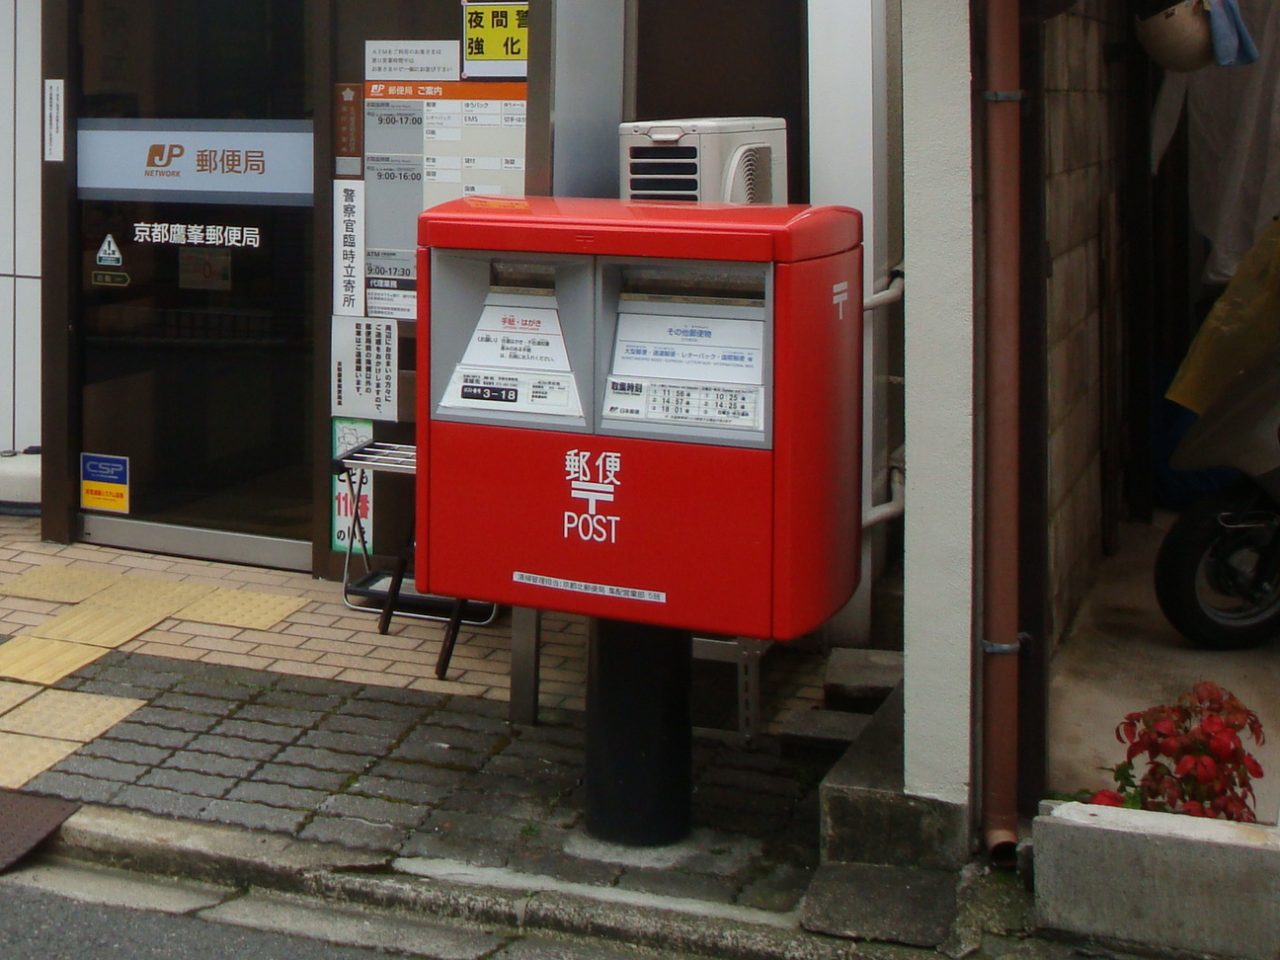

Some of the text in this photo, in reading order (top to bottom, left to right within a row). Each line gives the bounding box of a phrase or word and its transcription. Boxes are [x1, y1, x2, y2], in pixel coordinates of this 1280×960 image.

[467, 36, 521, 56] 強化
[377, 116, 423, 126] 9:00-17:00
[146, 143, 266, 175] JP 郵便局
[143, 169, 182, 178] NETWORK
[376, 172, 422, 181] 9:00-16:00
[133, 222, 260, 248] 京都鷹峯郵便局
[342, 187, 357, 308] 警察官臨時立寄所
[367, 265, 411, 277] 9:00-17:30
[501, 317, 542, 327] 手紙・はがき
[667, 328, 712, 338] その他郵便物
[482, 388, 516, 400] 3-18
[564, 448, 622, 485] 郵便
[563, 511, 621, 544] POST
